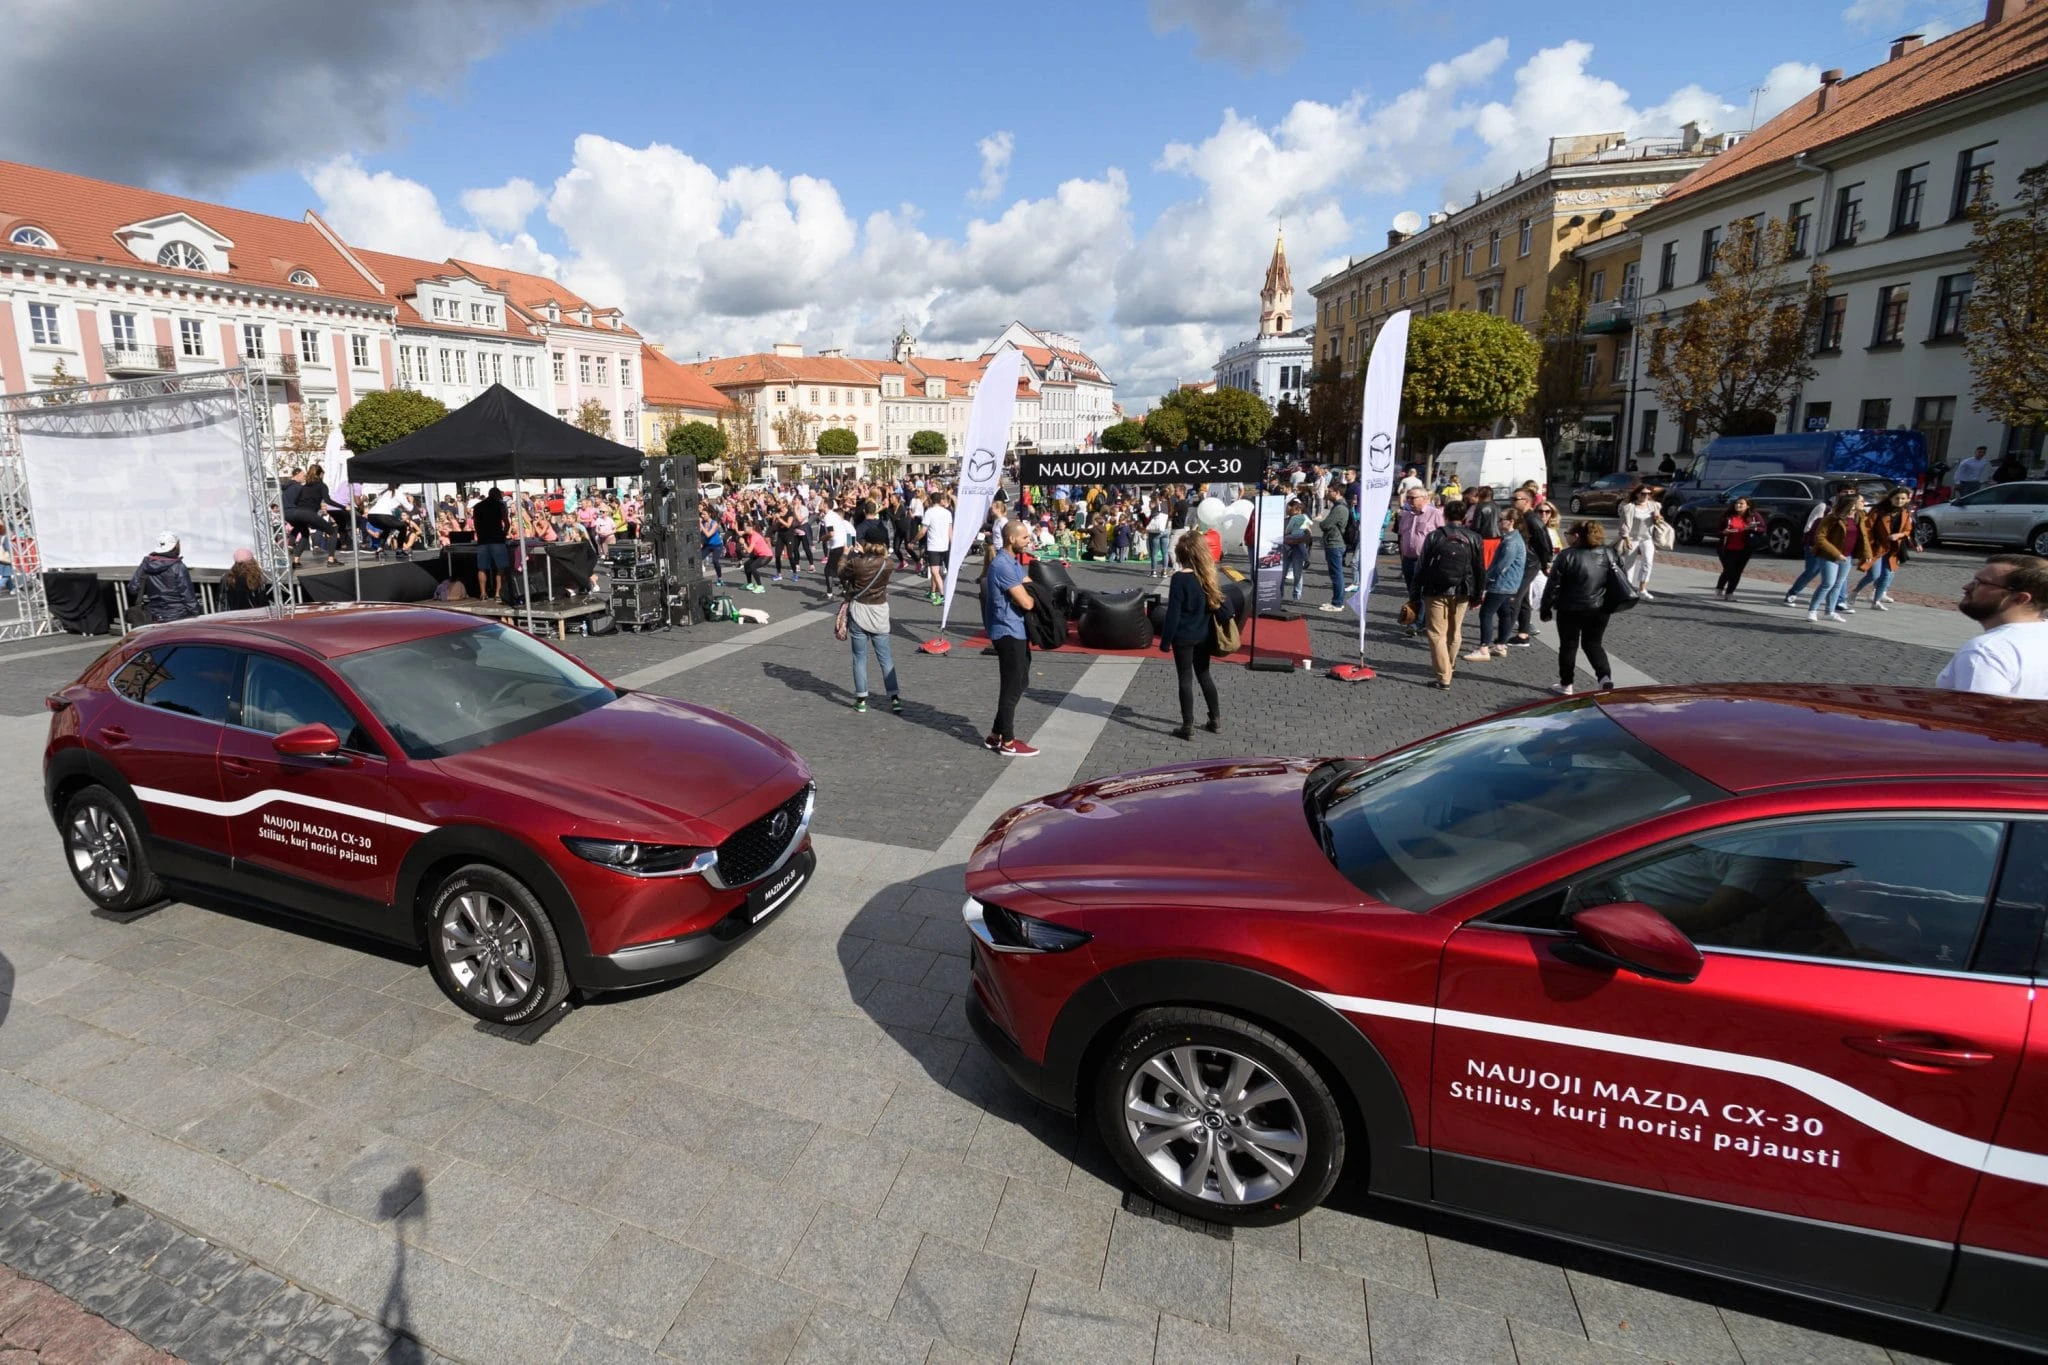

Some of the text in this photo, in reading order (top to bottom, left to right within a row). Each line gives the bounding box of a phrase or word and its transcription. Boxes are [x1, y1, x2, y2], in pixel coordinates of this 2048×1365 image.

[1039, 458, 1242, 479] NAUJOJI MAZDA CX-30
[258, 826, 378, 866] Stilius, kurį norisi pajausti
[263, 814, 371, 849] NAUJOJI MAZDA CX-30
[765, 881, 784, 901] MAZDA
[1466, 1058, 1824, 1138] NAUJOJI MAZDA CX-30
[1449, 1081, 1841, 1168] Stilius, kurį norisi pajausti
